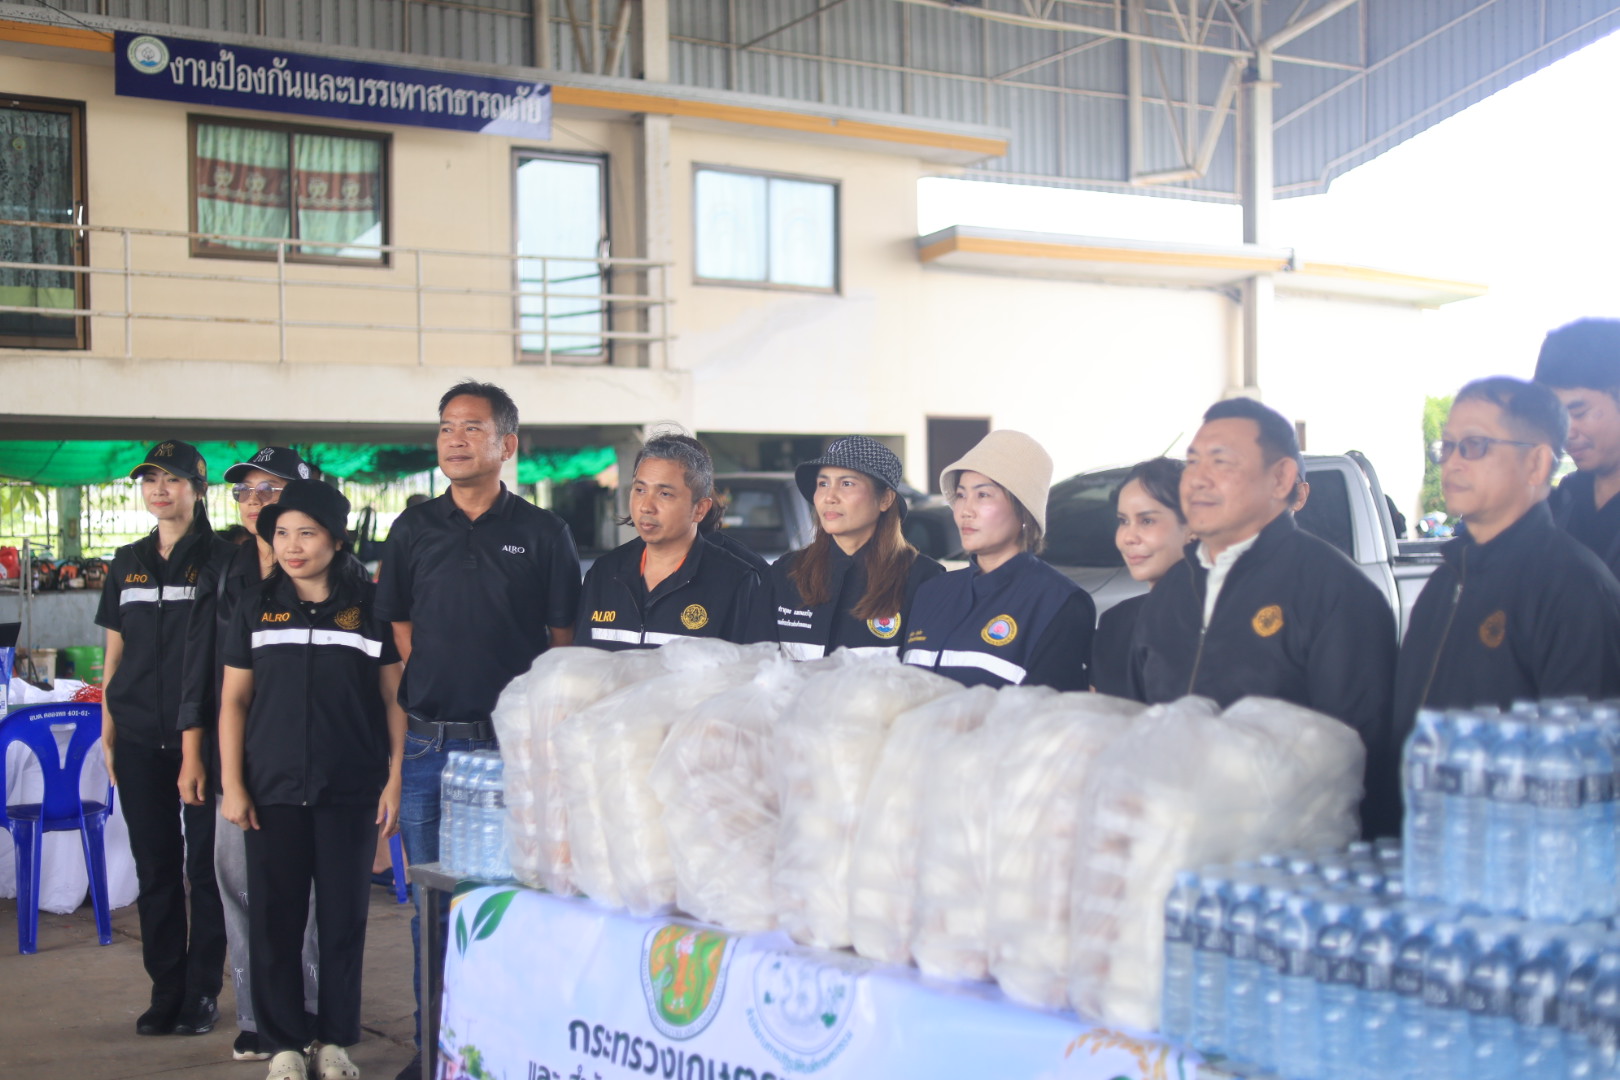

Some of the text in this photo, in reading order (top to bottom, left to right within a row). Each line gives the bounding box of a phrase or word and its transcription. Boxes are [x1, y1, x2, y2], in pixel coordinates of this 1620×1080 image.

[169, 50, 542, 124] งานป้องกันและบรรเทาสาธารณภัย
[124, 573, 149, 584] ALRO
[261, 612, 291, 623] ALRO
[591, 610, 616, 622] ALRO
